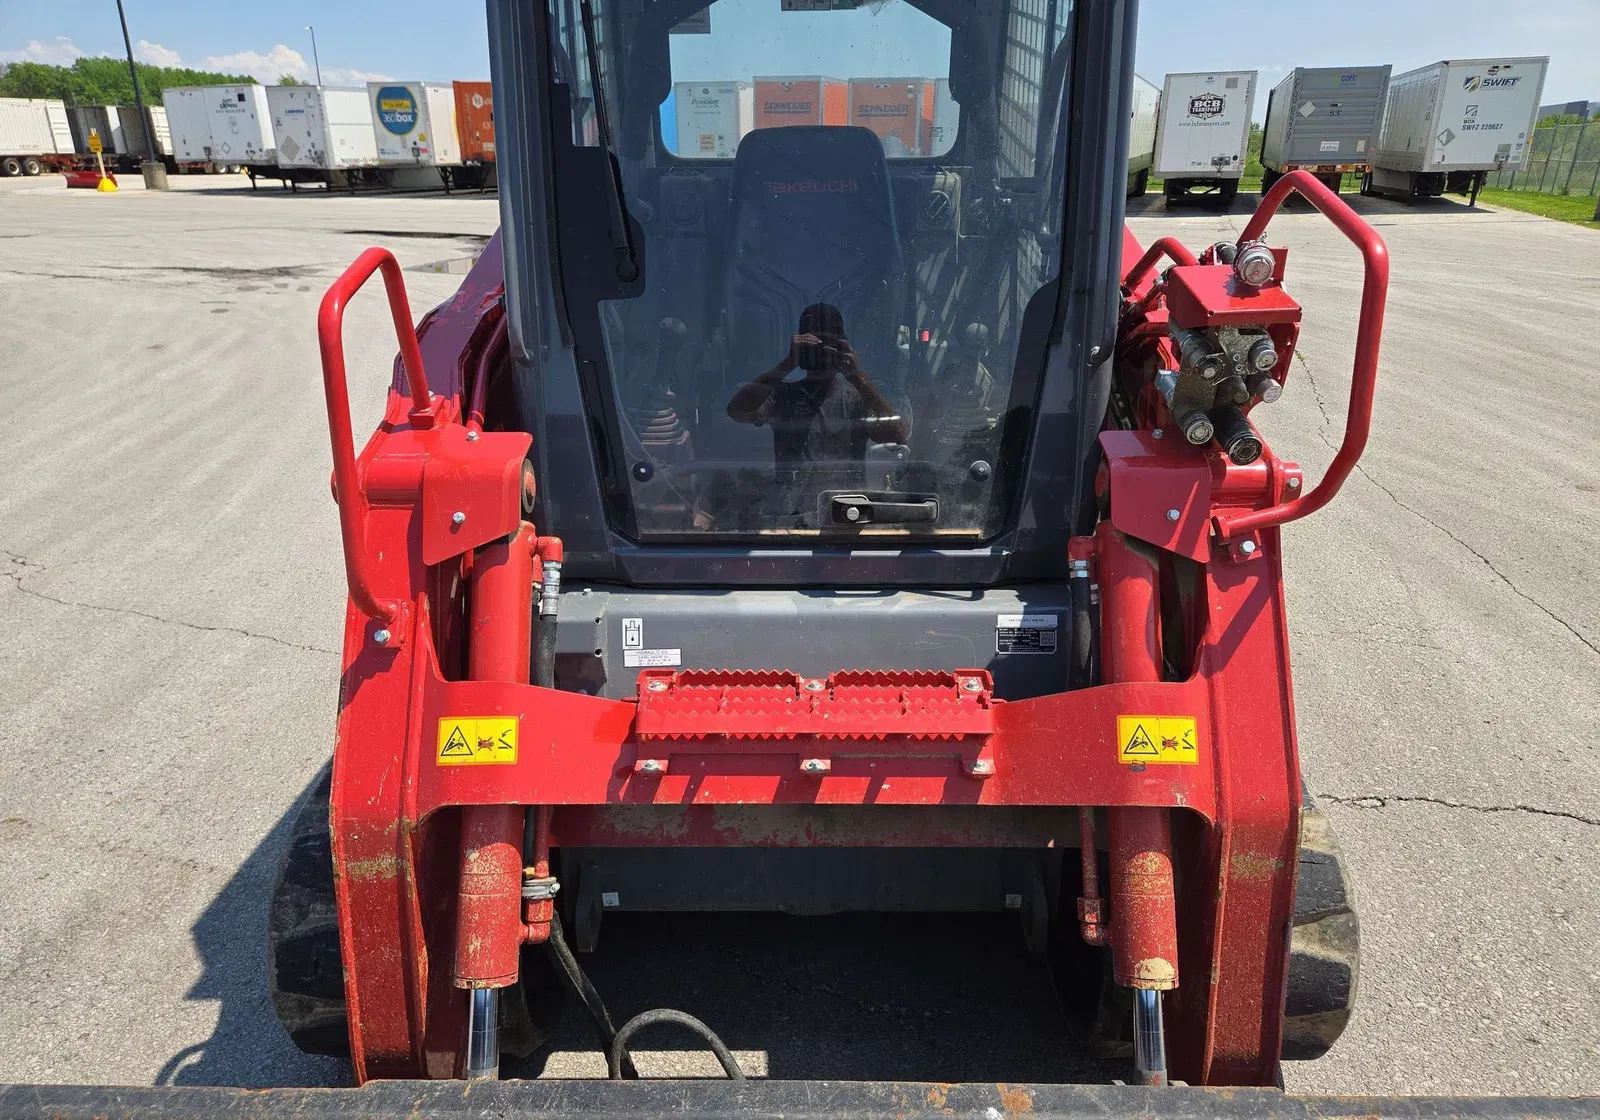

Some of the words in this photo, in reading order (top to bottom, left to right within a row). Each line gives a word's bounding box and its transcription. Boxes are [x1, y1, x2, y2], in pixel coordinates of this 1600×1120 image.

[1482, 77, 1521, 87] SWIFT
[691, 98, 720, 107] Premier
[763, 102, 811, 111] SCHNEIDER
[1193, 100, 1221, 108] BCB
[858, 104, 908, 113] SCHNEIDER
